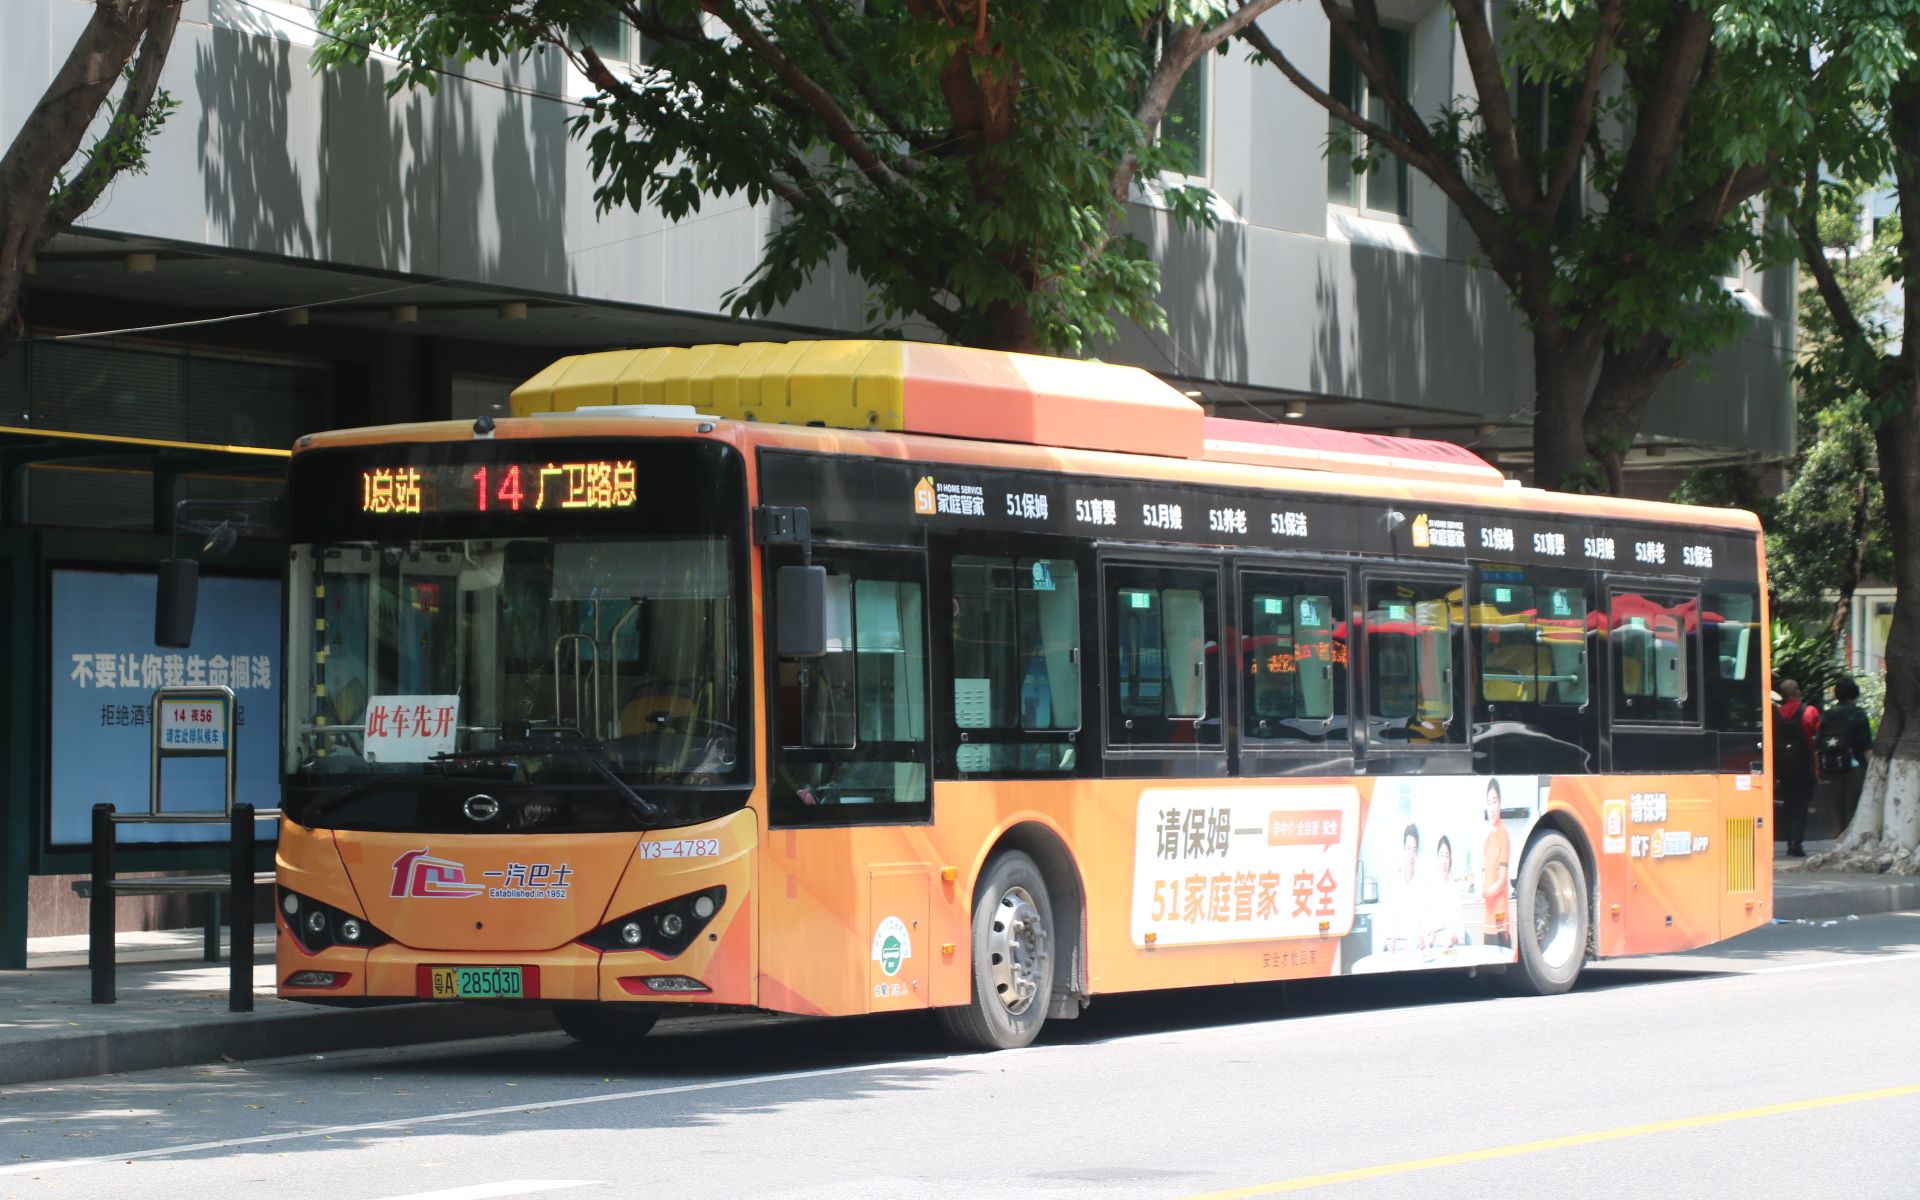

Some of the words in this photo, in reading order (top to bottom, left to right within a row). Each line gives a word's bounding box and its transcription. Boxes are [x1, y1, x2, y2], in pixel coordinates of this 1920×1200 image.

[474, 466, 523, 511] 14
[536, 461, 637, 511] 广卫路总
[943, 484, 960, 494] HOME
[961, 485, 983, 496] SERVICE
[918, 489, 933, 511] 51
[937, 493, 985, 516] 家庭管家
[1006, 493, 1049, 520] 51保姆
[1076, 498, 1117, 526] 51育婴
[1209, 508, 1248, 534] 51养老
[1271, 512, 1308, 537] 51保洁
[71, 653, 272, 690] 不要让你我生命搁浅
[174, 709, 186, 722] 14
[367, 703, 456, 739] 此车先开
[166, 728, 219, 744] 请在此排队候车
[641, 840, 719, 859] Y3-4782
[1692, 836, 1708, 851] APP
[483, 863, 574, 887] 一汽巴士
[490, 888, 534, 899] Established
[536, 888, 544, 899] in
[546, 888, 566, 899] 1952
[1151, 870, 1281, 925] 51家庭管家
[1291, 867, 1338, 918] 安全
